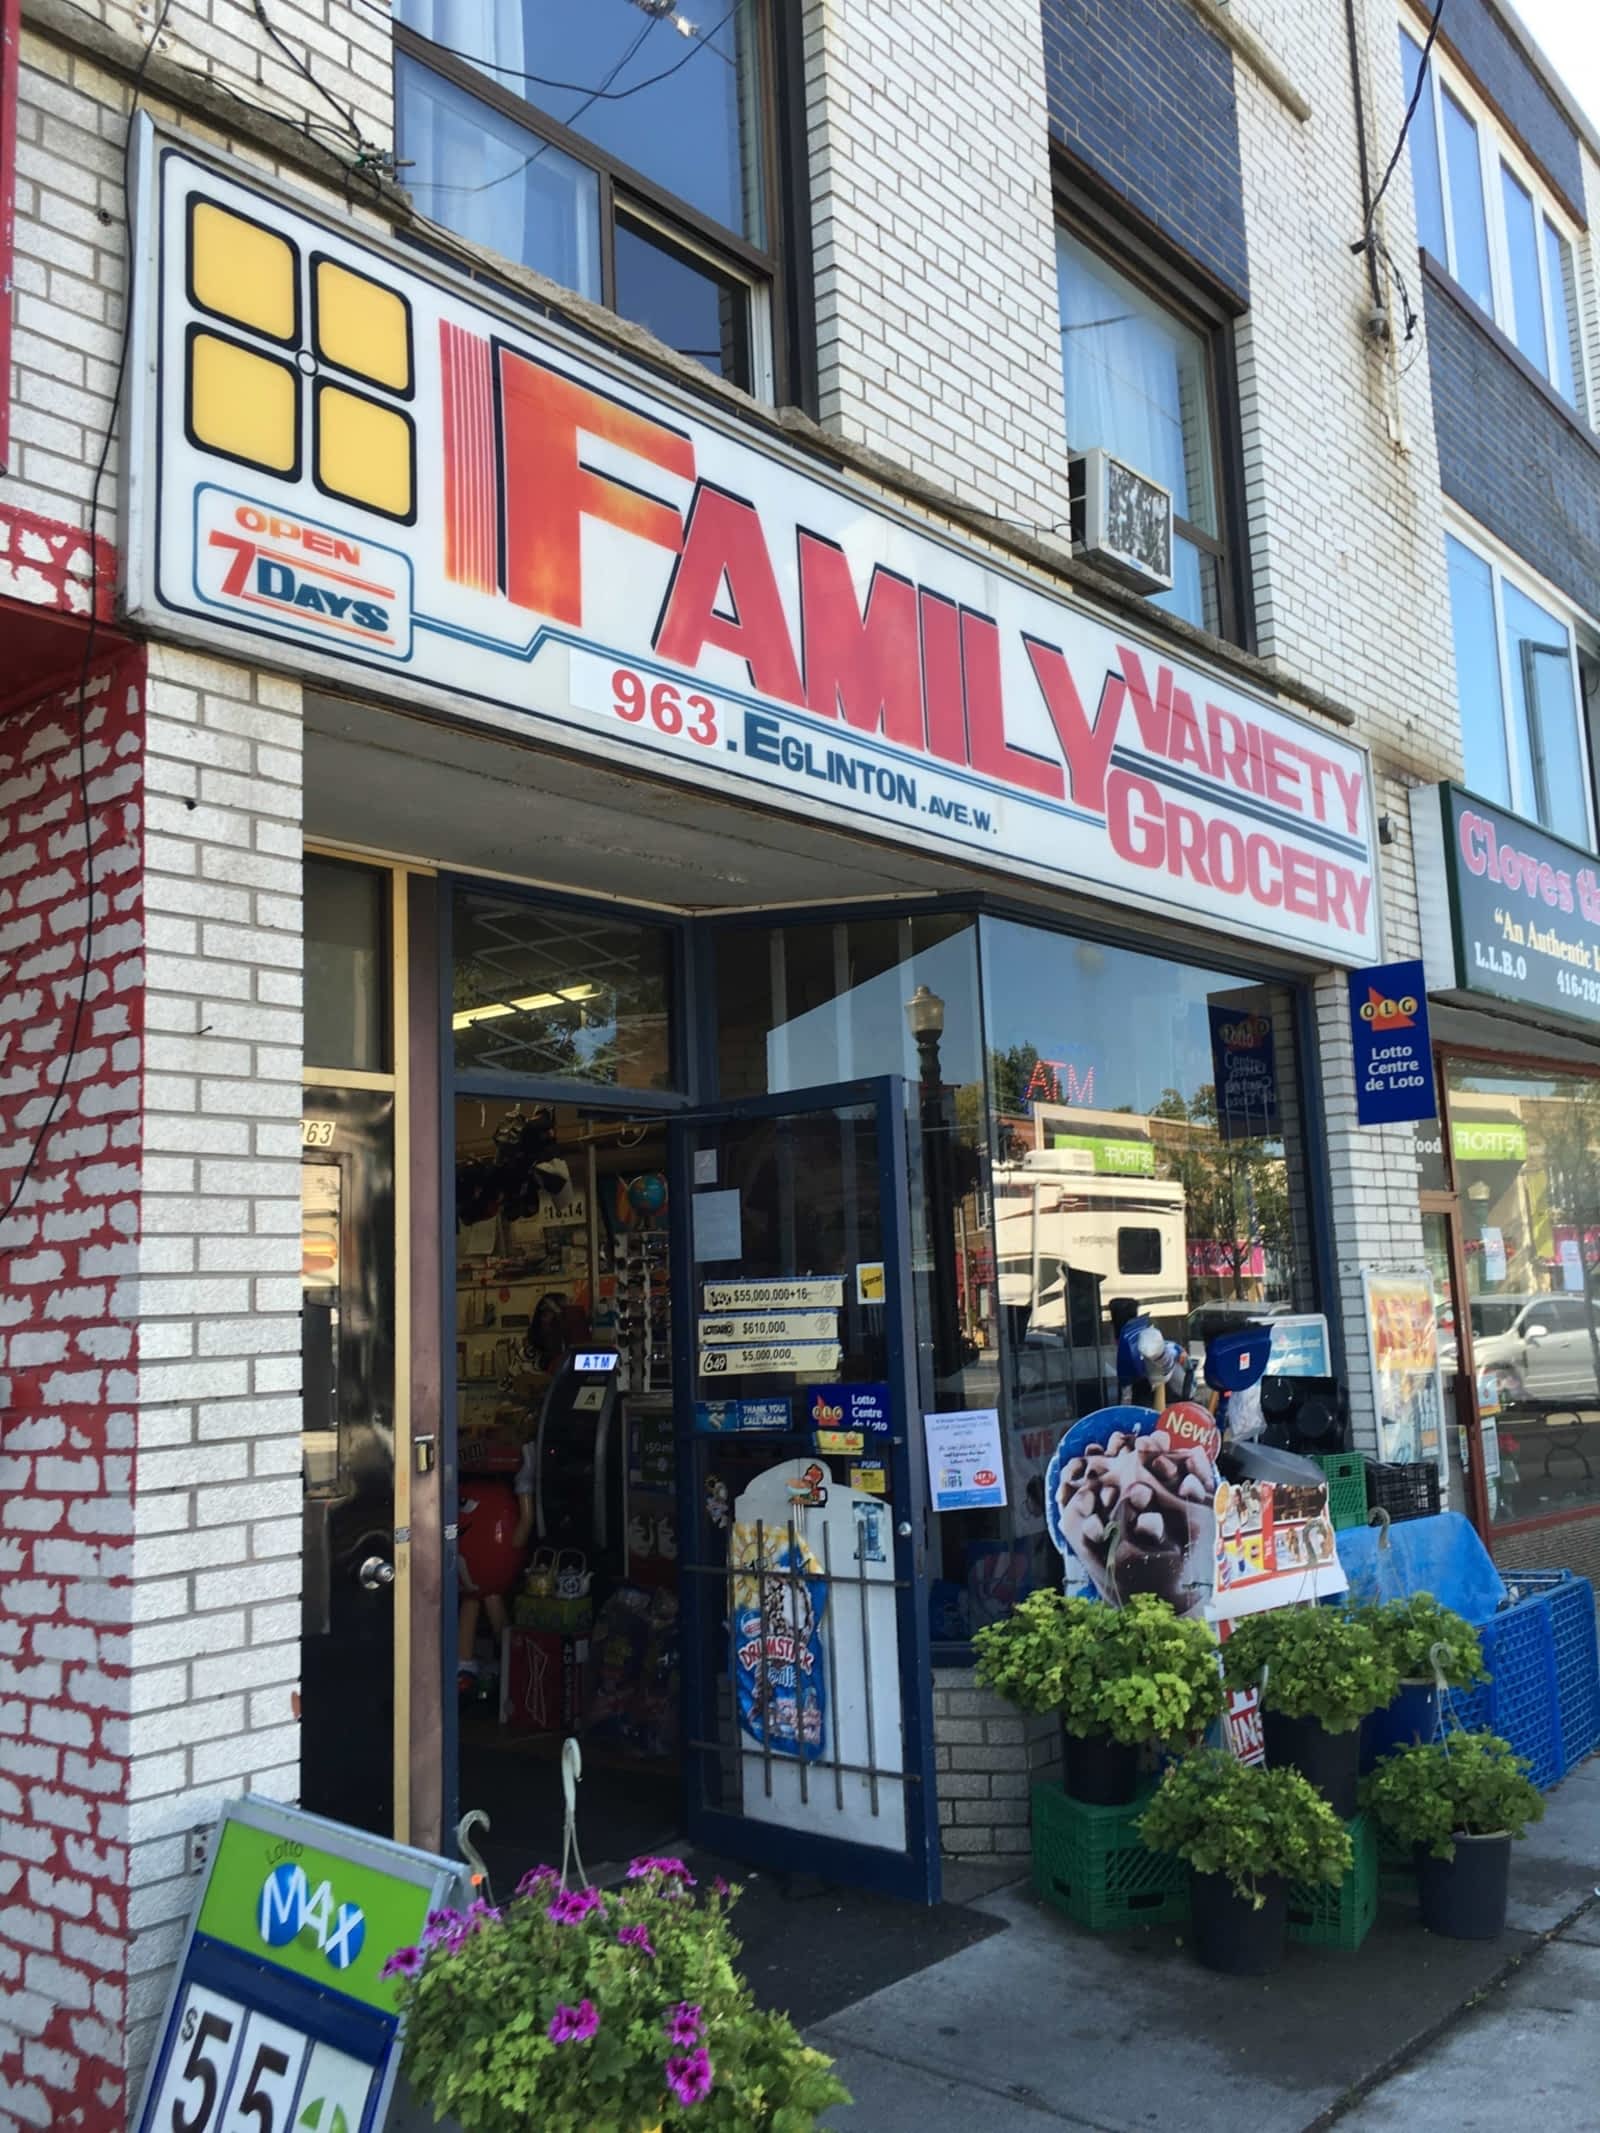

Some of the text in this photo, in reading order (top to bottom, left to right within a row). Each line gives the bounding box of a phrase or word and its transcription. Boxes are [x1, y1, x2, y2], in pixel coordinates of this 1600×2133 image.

[234, 505, 361, 567] OPEN
[208, 529, 390, 633] 7 DAYS
[492, 335, 1127, 813] FAMILY
[611, 669, 718, 746] 963
[1115, 644, 1364, 837] VARIETY
[1105, 767, 1371, 936] GROCERY
[1459, 810, 1574, 914] Cloves
[1527, 920, 1592, 969] Authentic
[1361, 997, 1416, 1020] OLG
[1368, 1058, 1419, 1075] Centre
[1371, 1045, 1413, 1061] Lotto
[1026, 1059, 1095, 1104] ATM
[1365, 1074, 1424, 1091] de Loto
[300, 1122, 333, 1145] 63
[582, 1354, 611, 1368] ATM
[851, 1394, 876, 1405] Lotto
[851, 1406, 882, 1418] Centre
[1166, 1411, 1217, 1446] New!
[266, 1840, 304, 1865] Lotto
[260, 1864, 365, 1969] MAX
